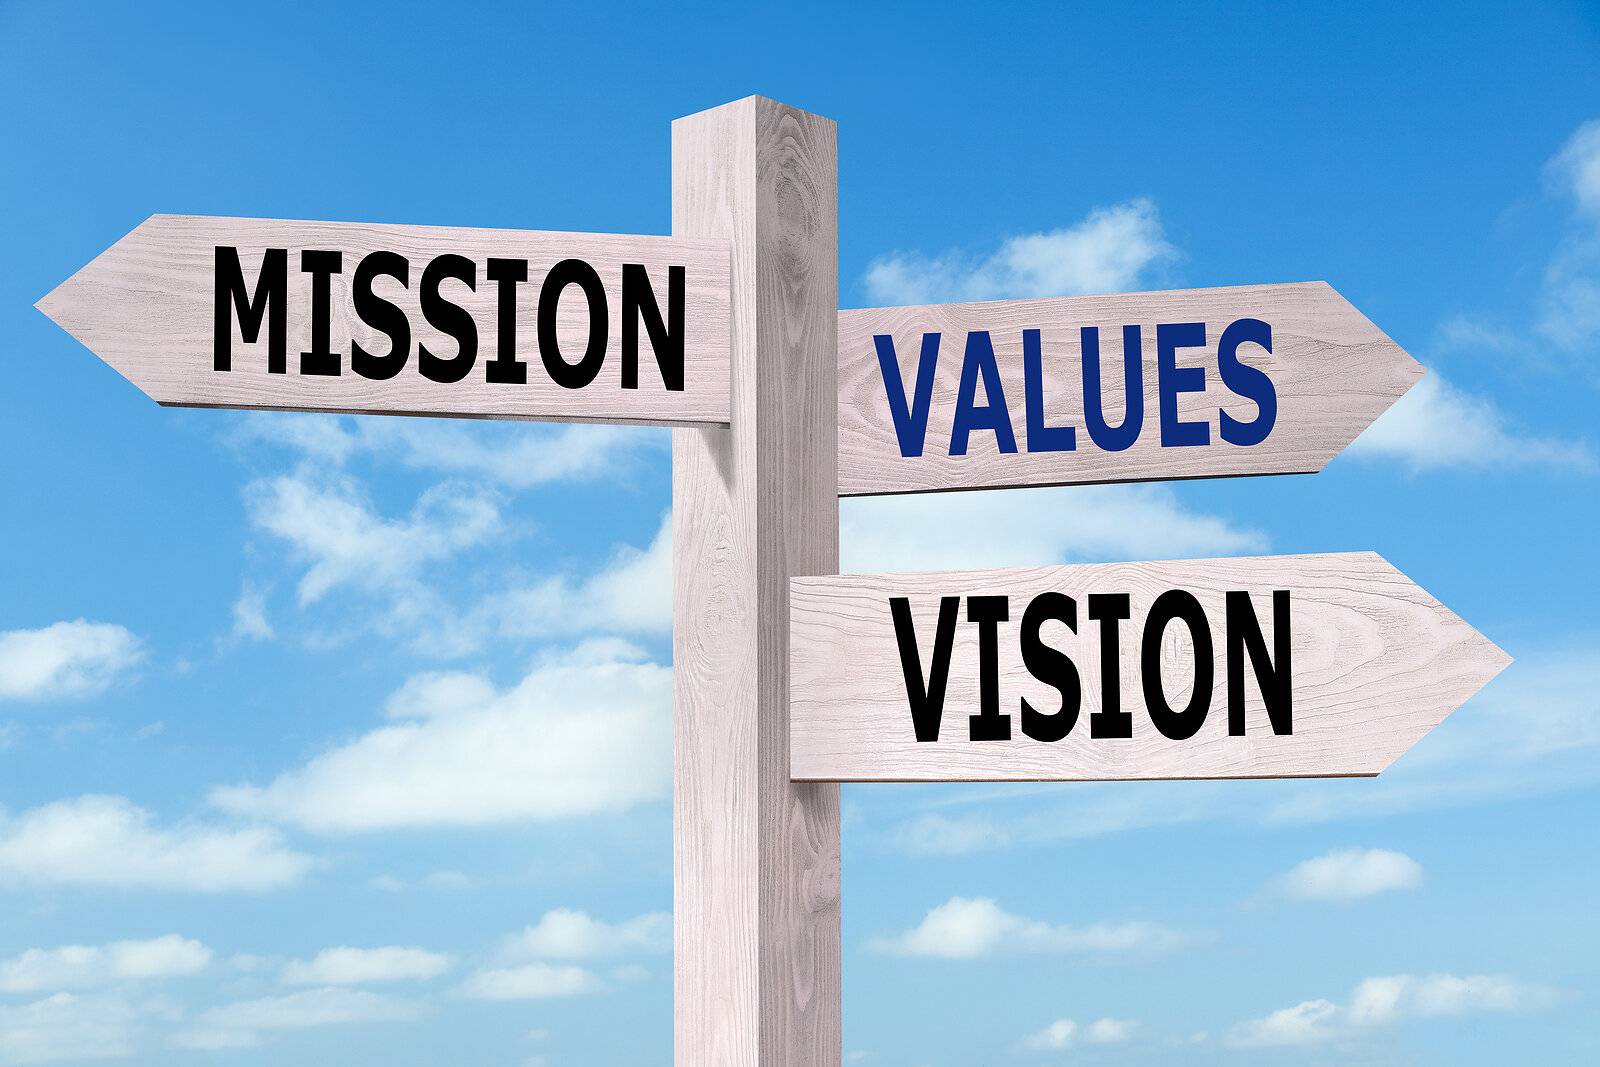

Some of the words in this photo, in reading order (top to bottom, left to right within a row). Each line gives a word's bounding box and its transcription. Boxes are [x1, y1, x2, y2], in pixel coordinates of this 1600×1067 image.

[213, 245, 686, 392] MISSION
[873, 318, 1278, 458] VALUES
[889, 589, 1293, 743] VISION
